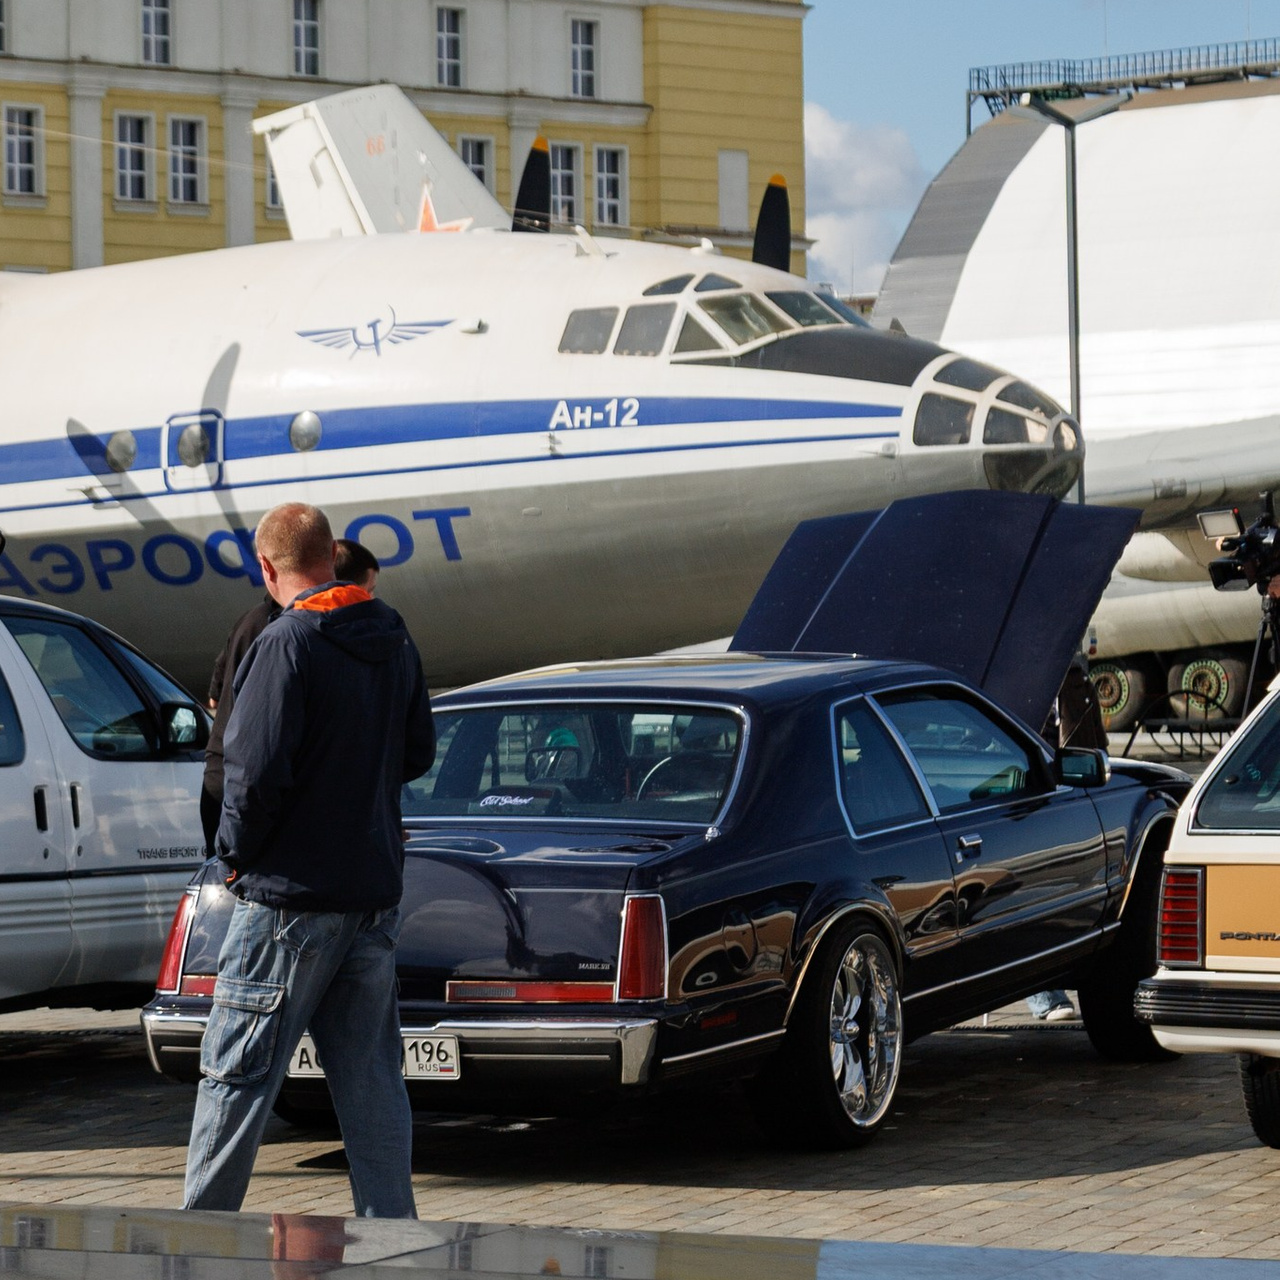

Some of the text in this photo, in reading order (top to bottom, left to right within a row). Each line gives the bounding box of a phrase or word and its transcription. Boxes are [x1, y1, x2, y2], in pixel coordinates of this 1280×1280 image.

[548, 397, 640, 429] Ан-12
[137, 847, 168, 859] TRANS
[169, 846, 198, 858] SPORT
[408, 1040, 449, 1063] 196
[417, 1063, 439, 1072] RUS
